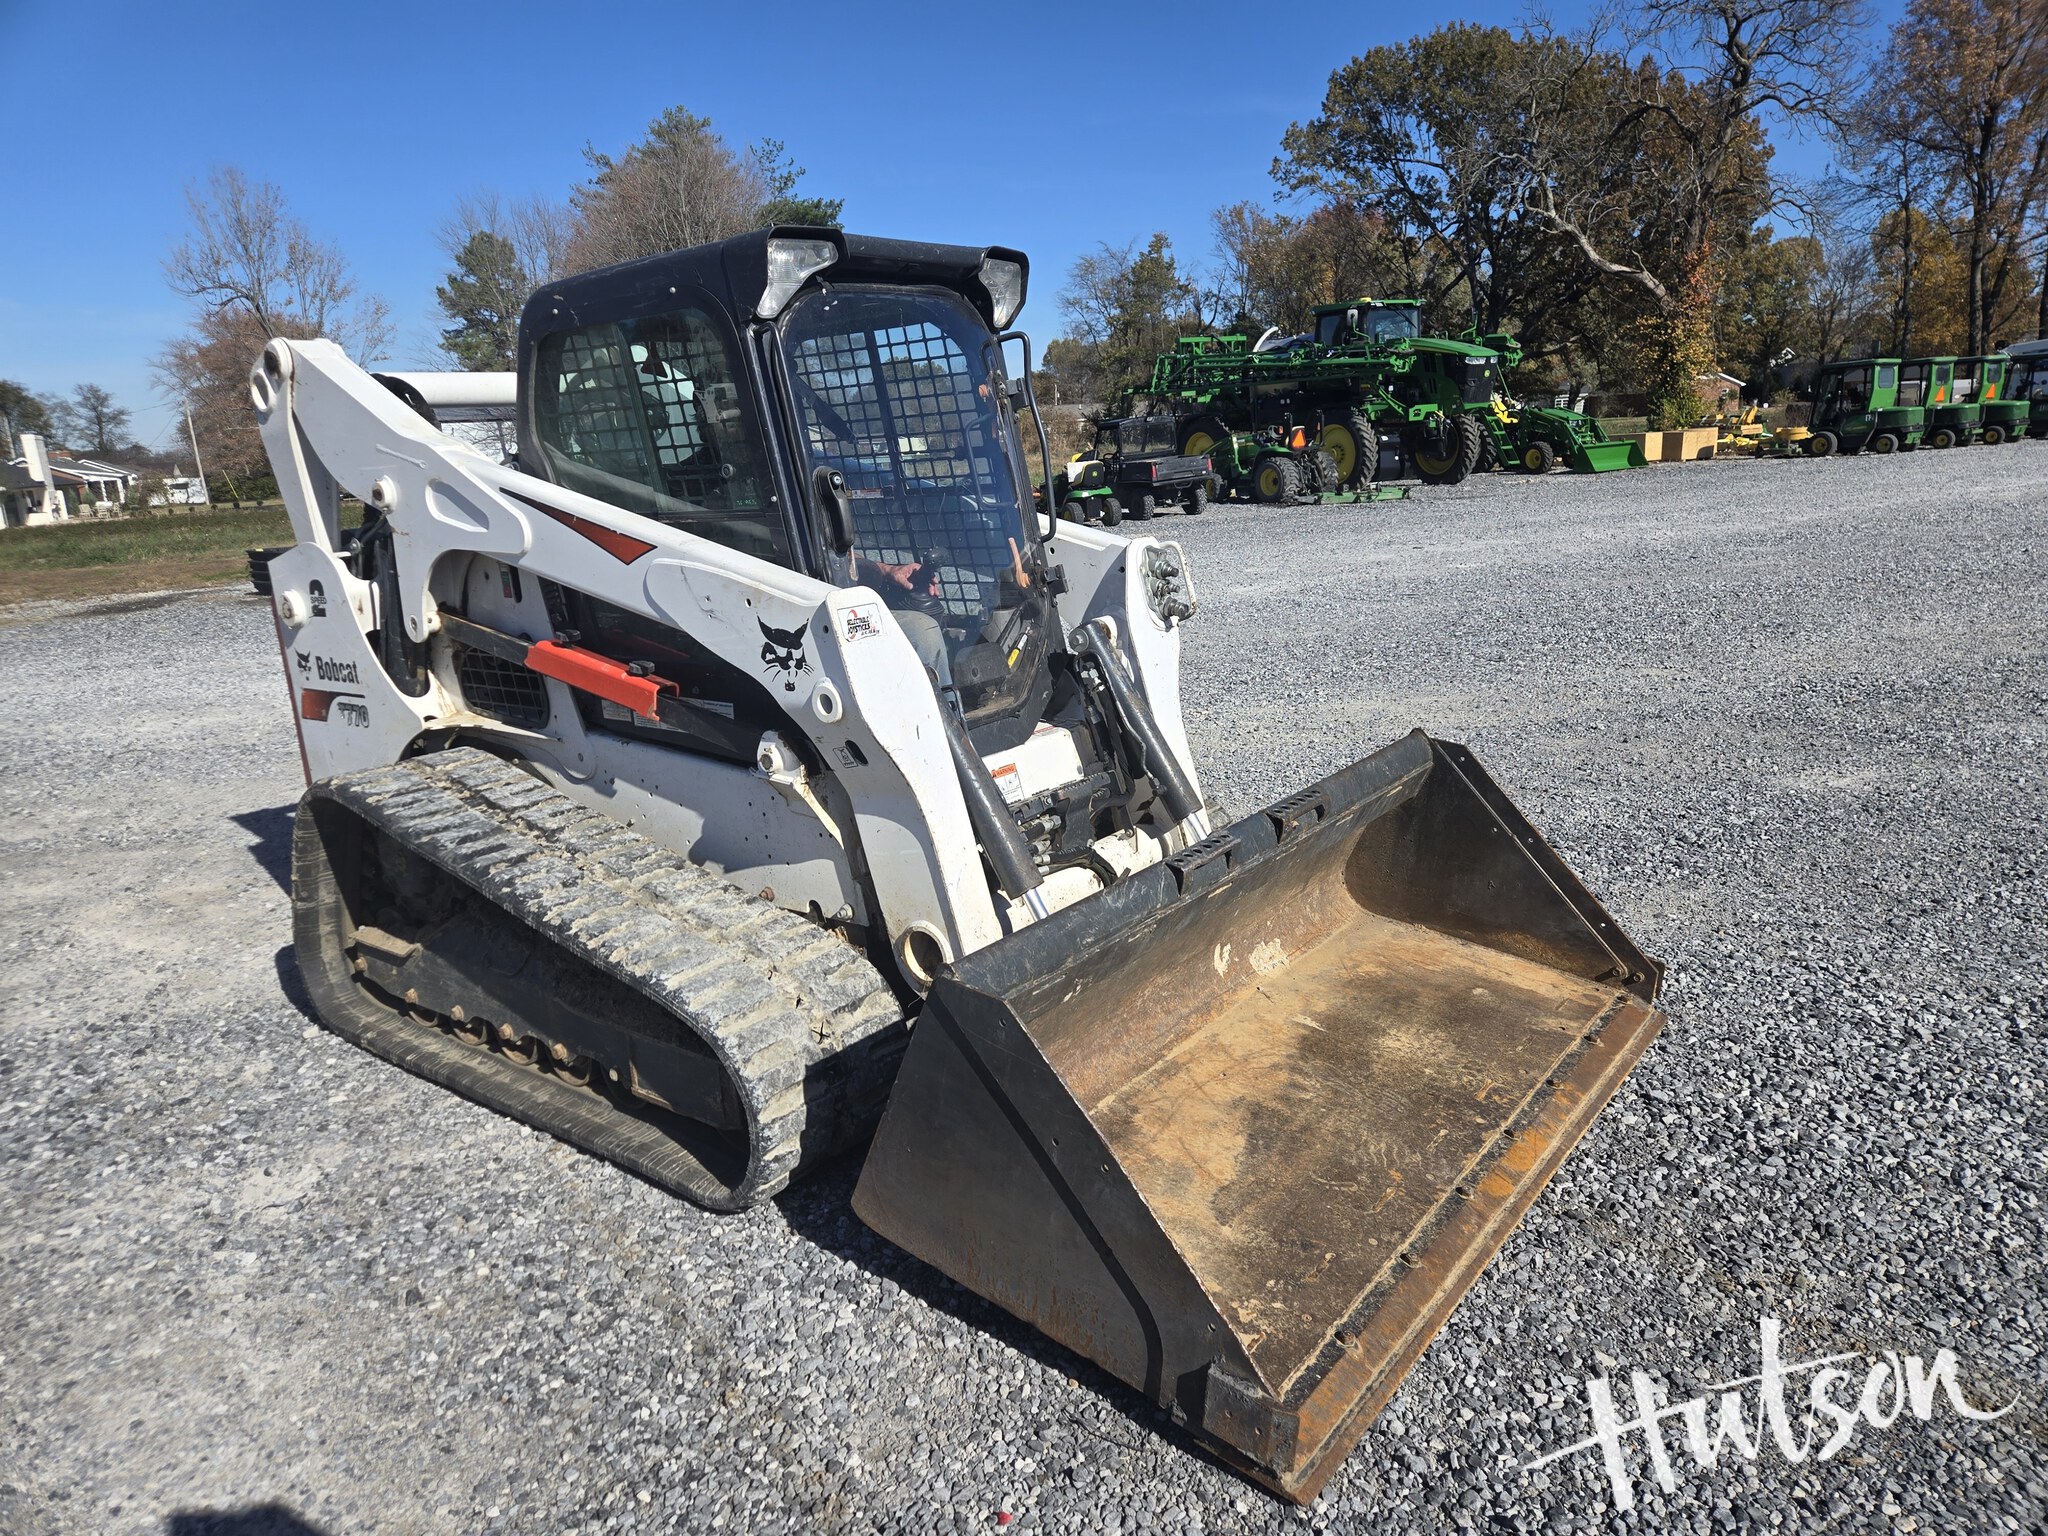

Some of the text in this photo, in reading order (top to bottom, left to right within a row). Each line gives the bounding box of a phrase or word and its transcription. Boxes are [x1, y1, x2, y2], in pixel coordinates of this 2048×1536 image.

[310, 596, 327, 604] SPEED
[847, 622, 870, 635] JOYSTICKS
[315, 656, 360, 684] Bobcat
